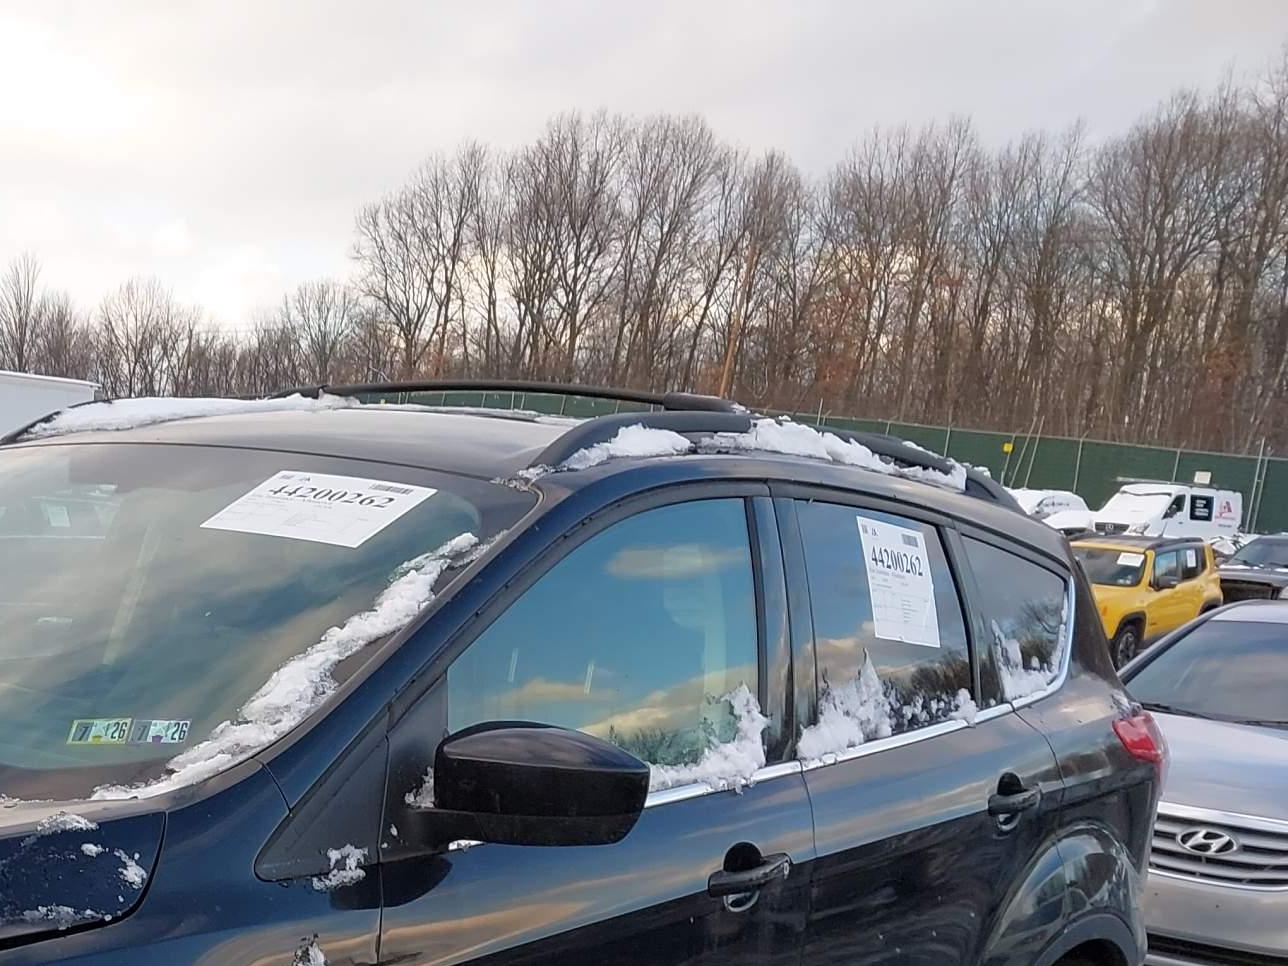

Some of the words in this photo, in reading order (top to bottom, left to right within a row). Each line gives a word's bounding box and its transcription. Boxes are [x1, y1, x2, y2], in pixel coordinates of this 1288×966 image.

[268, 484, 395, 509] 44200262
[871, 545, 923, 577] 44200262
[110, 722, 127, 739] 26
[170, 722, 188, 740] 26
